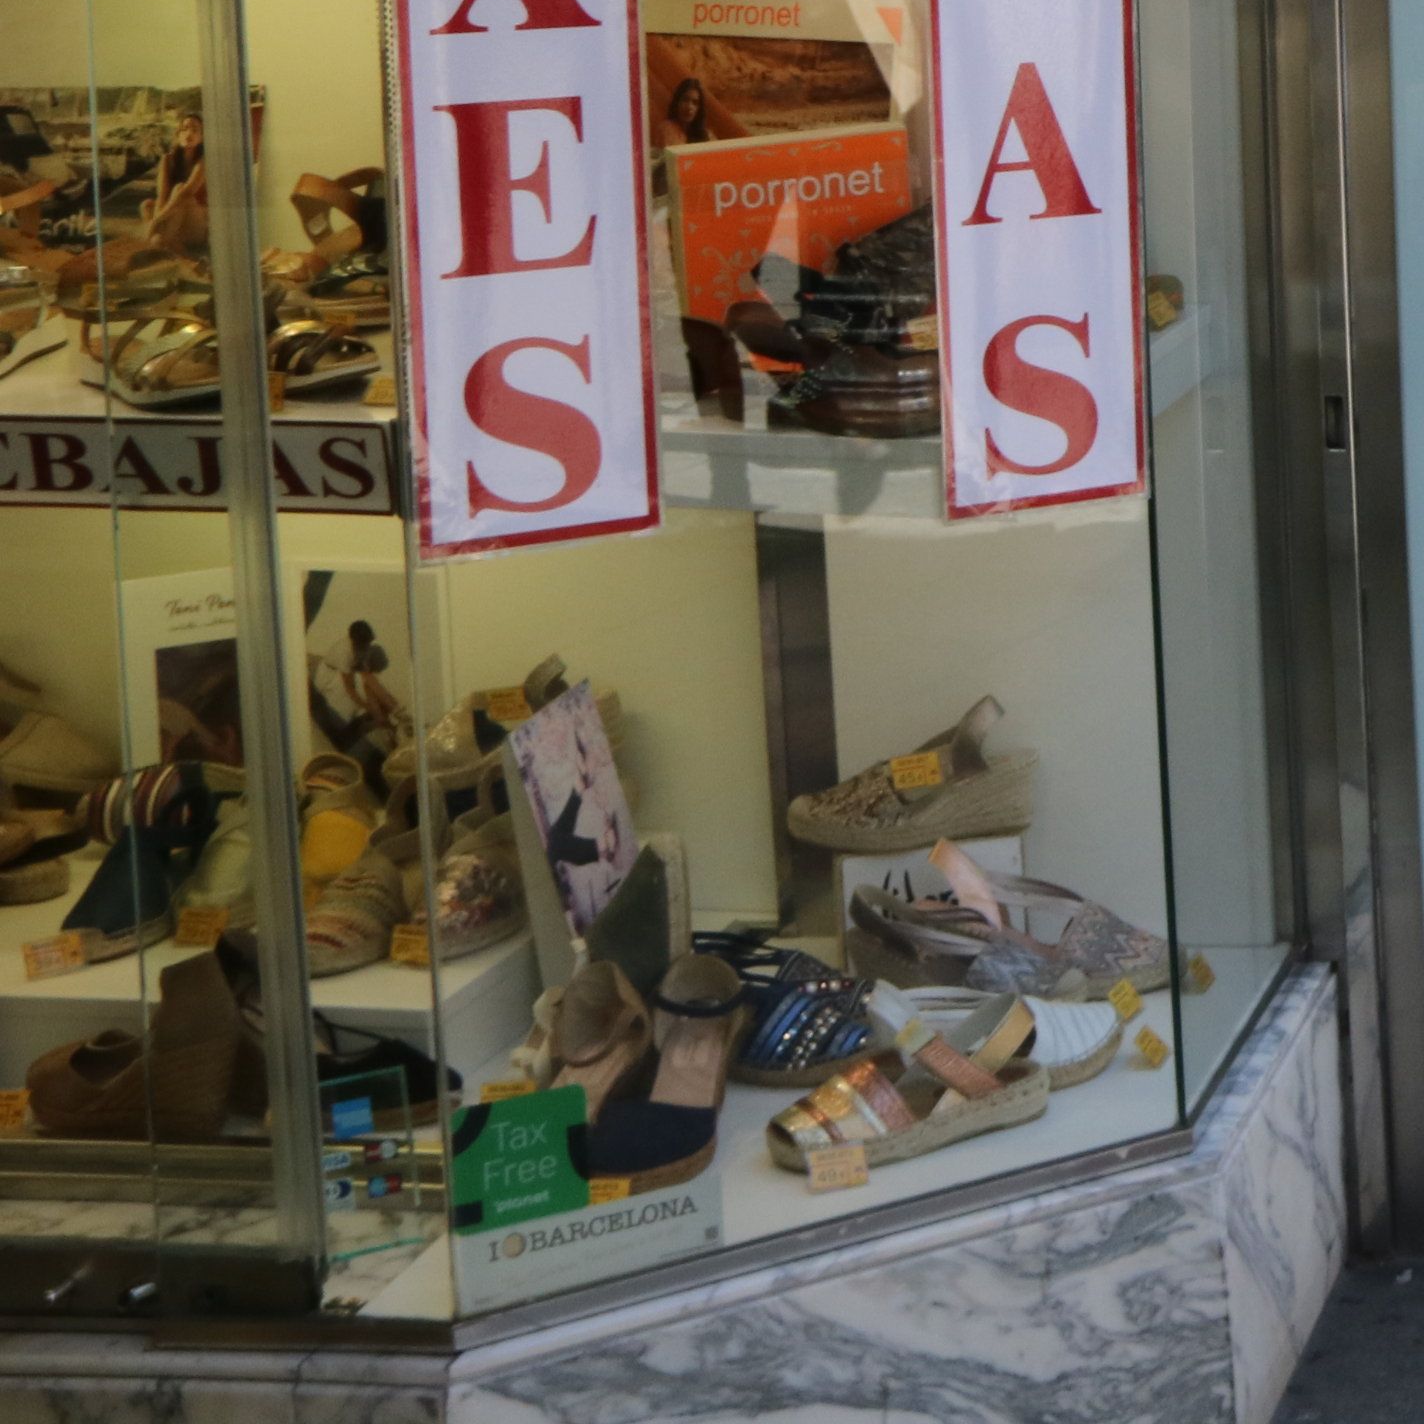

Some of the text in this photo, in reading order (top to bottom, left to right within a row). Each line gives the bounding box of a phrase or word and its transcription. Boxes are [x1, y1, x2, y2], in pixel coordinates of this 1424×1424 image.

[693, 2, 801, 27] porronet
[714, 162, 885, 218] porronet
[496, 1121, 548, 1153] Tax
[484, 1155, 557, 1191] Free
[529, 1196, 698, 1252] BARCELONA
